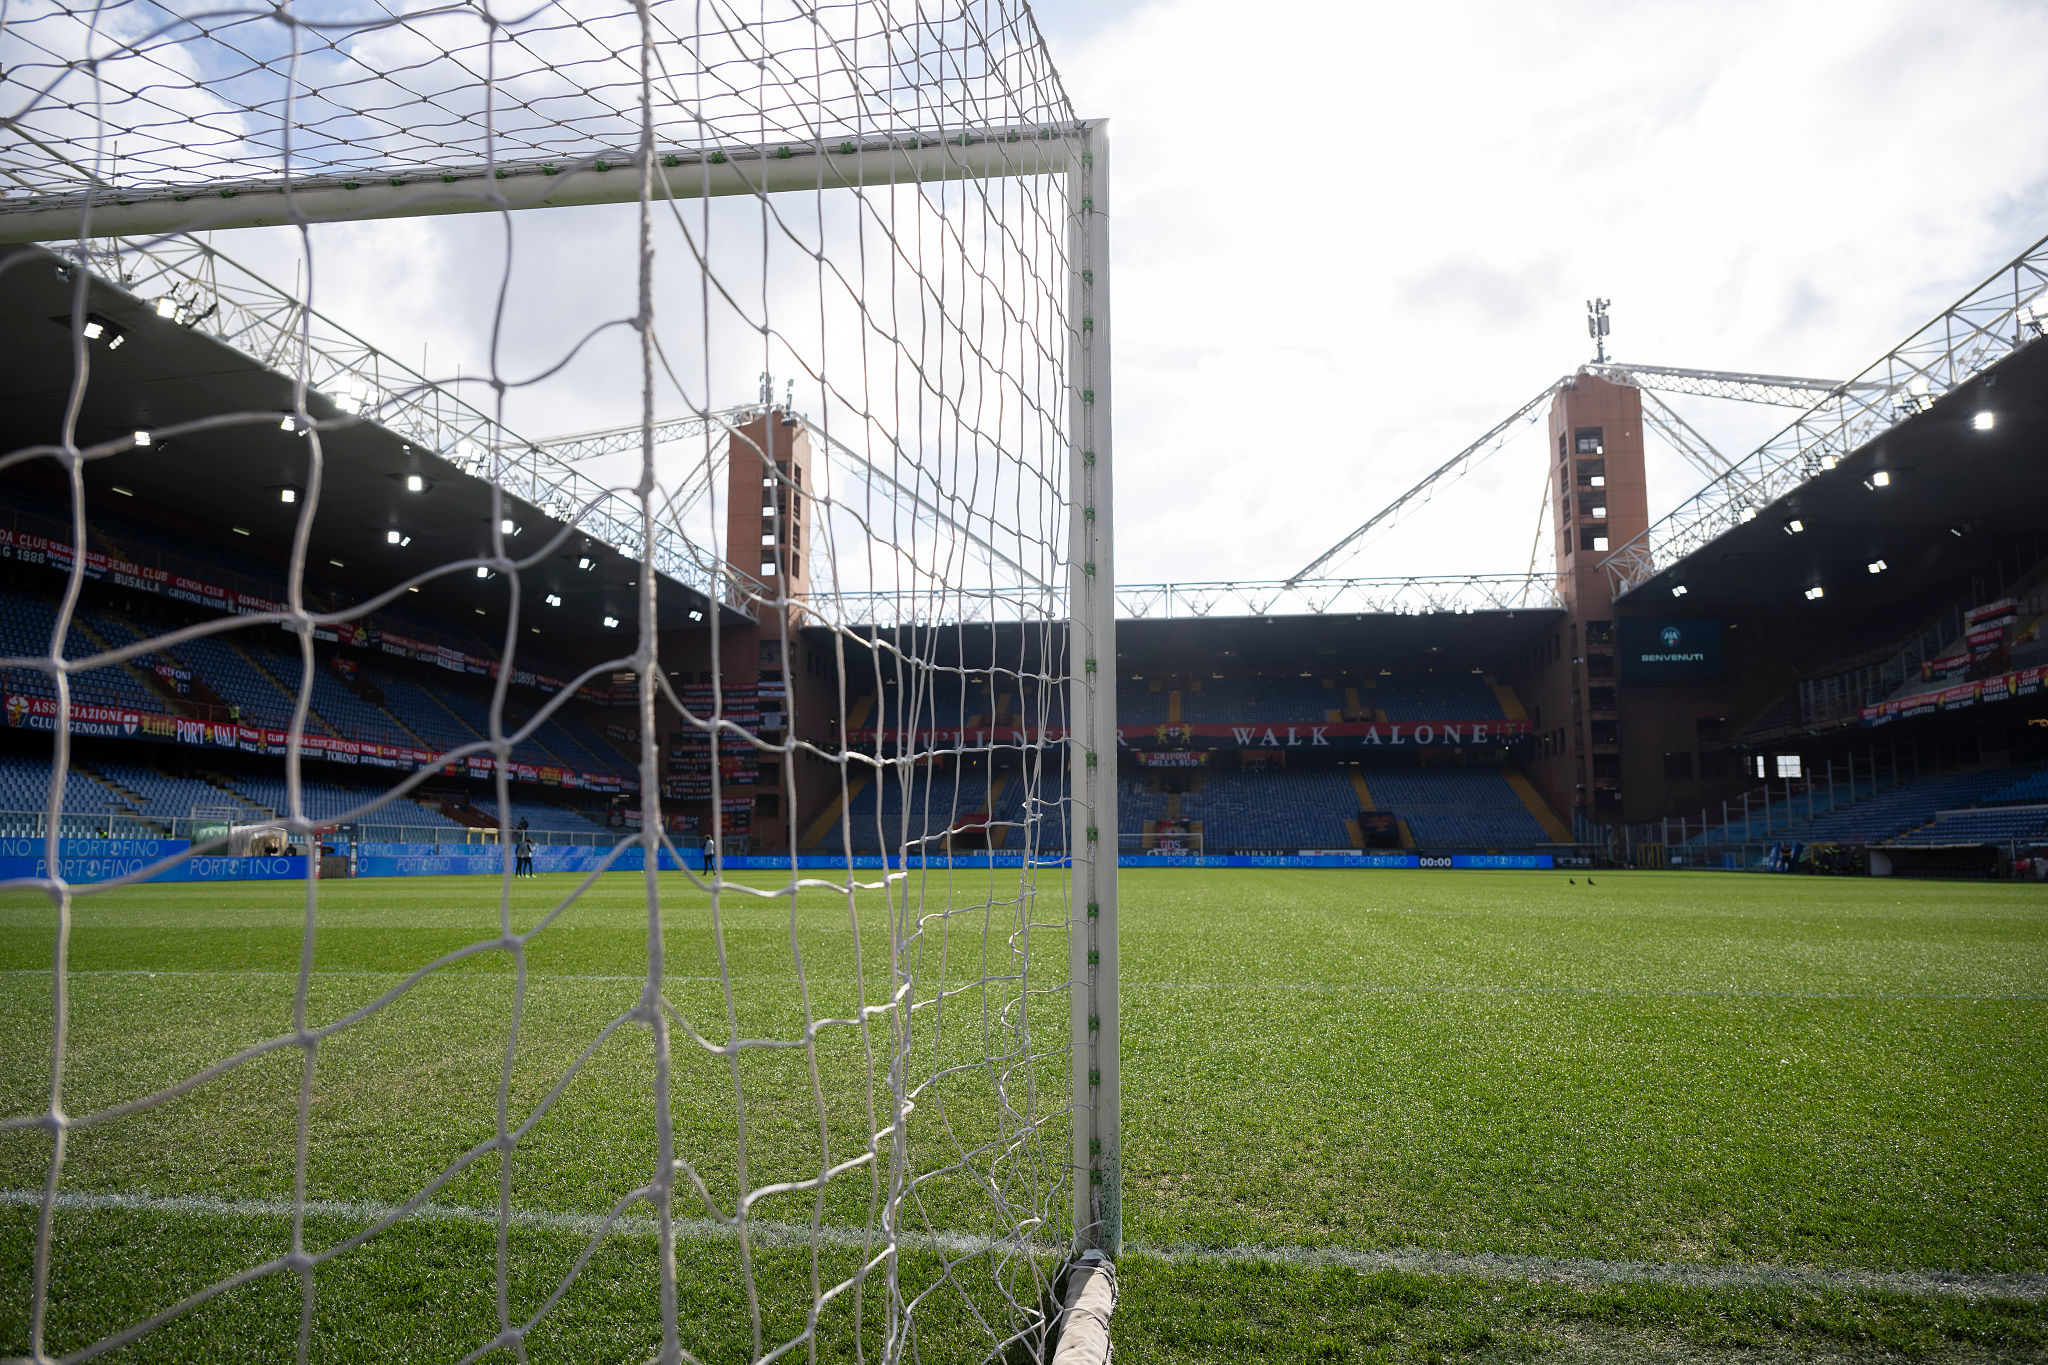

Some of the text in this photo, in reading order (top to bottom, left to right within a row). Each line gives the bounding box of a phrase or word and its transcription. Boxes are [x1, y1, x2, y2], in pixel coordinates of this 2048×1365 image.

[16, 549, 46, 566] 1988
[143, 567, 168, 583] CLUB
[115, 573, 161, 594] BUSALLA
[176, 577, 225, 599] GENOA CLUB
[168, 587, 201, 605] GRIFONE
[238, 594, 260, 608] GENOA
[1641, 653, 1704, 662] BENVENUTI
[32, 701, 124, 722] ASSCIAZIONE
[68, 721, 119, 736] GENOANI
[141, 714, 176, 737] Little
[177, 719, 206, 745] PORT
[268, 732, 285, 743] CLUB
[1231, 726, 1331, 746] WALK
[1362, 724, 1489, 745] ALONE
[326, 739, 360, 755] GRIFONI
[383, 748, 398, 757] CLUB
[327, 751, 359, 766] TORINO
[1179, 759, 1198, 767] SUD
[66, 839, 159, 857] PORTOFINO
[337, 844, 393, 856] POTOFINO
[36, 858, 291, 879] PRTOFINO PORTOFINO
[909, 856, 968, 866] PORTOFNO
[1251, 856, 1313, 866] PORTOFINO
[1344, 856, 1408, 866] PORTOFINO
[1420, 857, 1452, 867] 00:00
[1471, 856, 1536, 865] PORTOFINO
